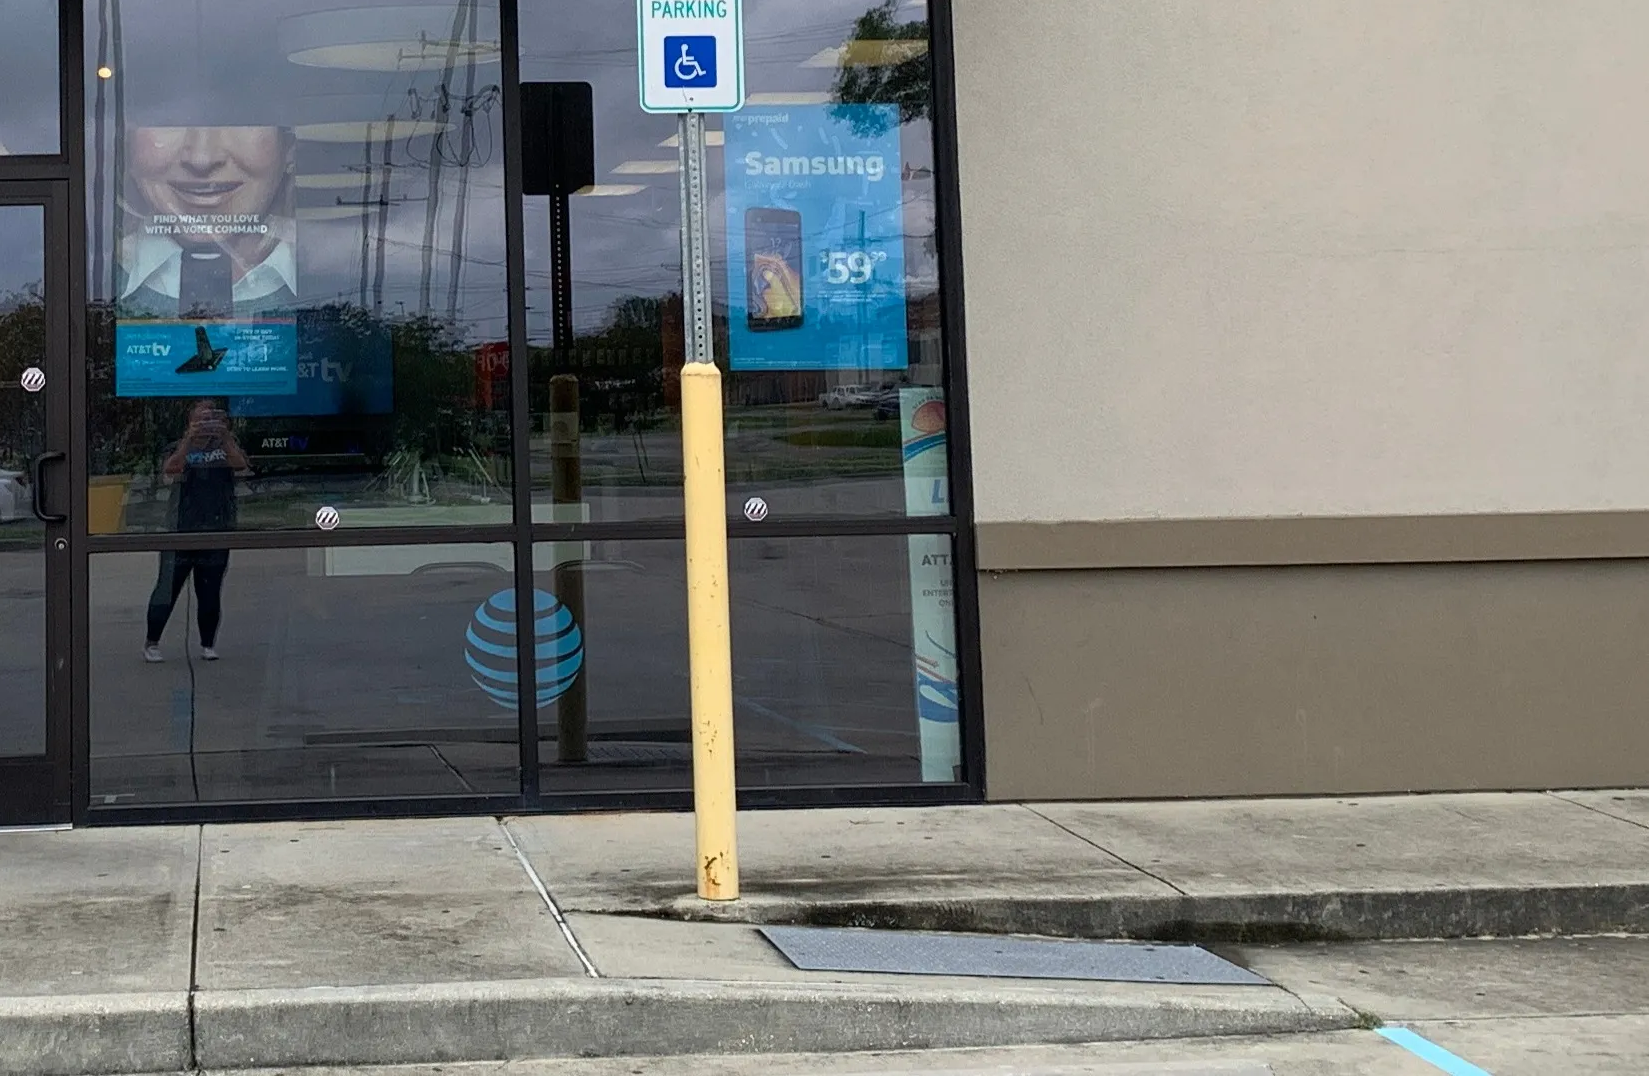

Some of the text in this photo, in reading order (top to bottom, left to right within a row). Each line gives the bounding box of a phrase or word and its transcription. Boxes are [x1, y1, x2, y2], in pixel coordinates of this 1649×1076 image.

[651, 0, 727, 19] PARKING
[747, 112, 789, 126] prepaid
[745, 151, 884, 182] Samsung
[153, 214, 259, 224] FIND WHAT YOU LOVE
[145, 225, 268, 234] WITH A VOICE COMMAND
[126, 342, 172, 357] AT&T tv
[320, 357, 352, 382] tv
[261, 437, 289, 448] AT&T
[921, 554, 953, 566] ATT
